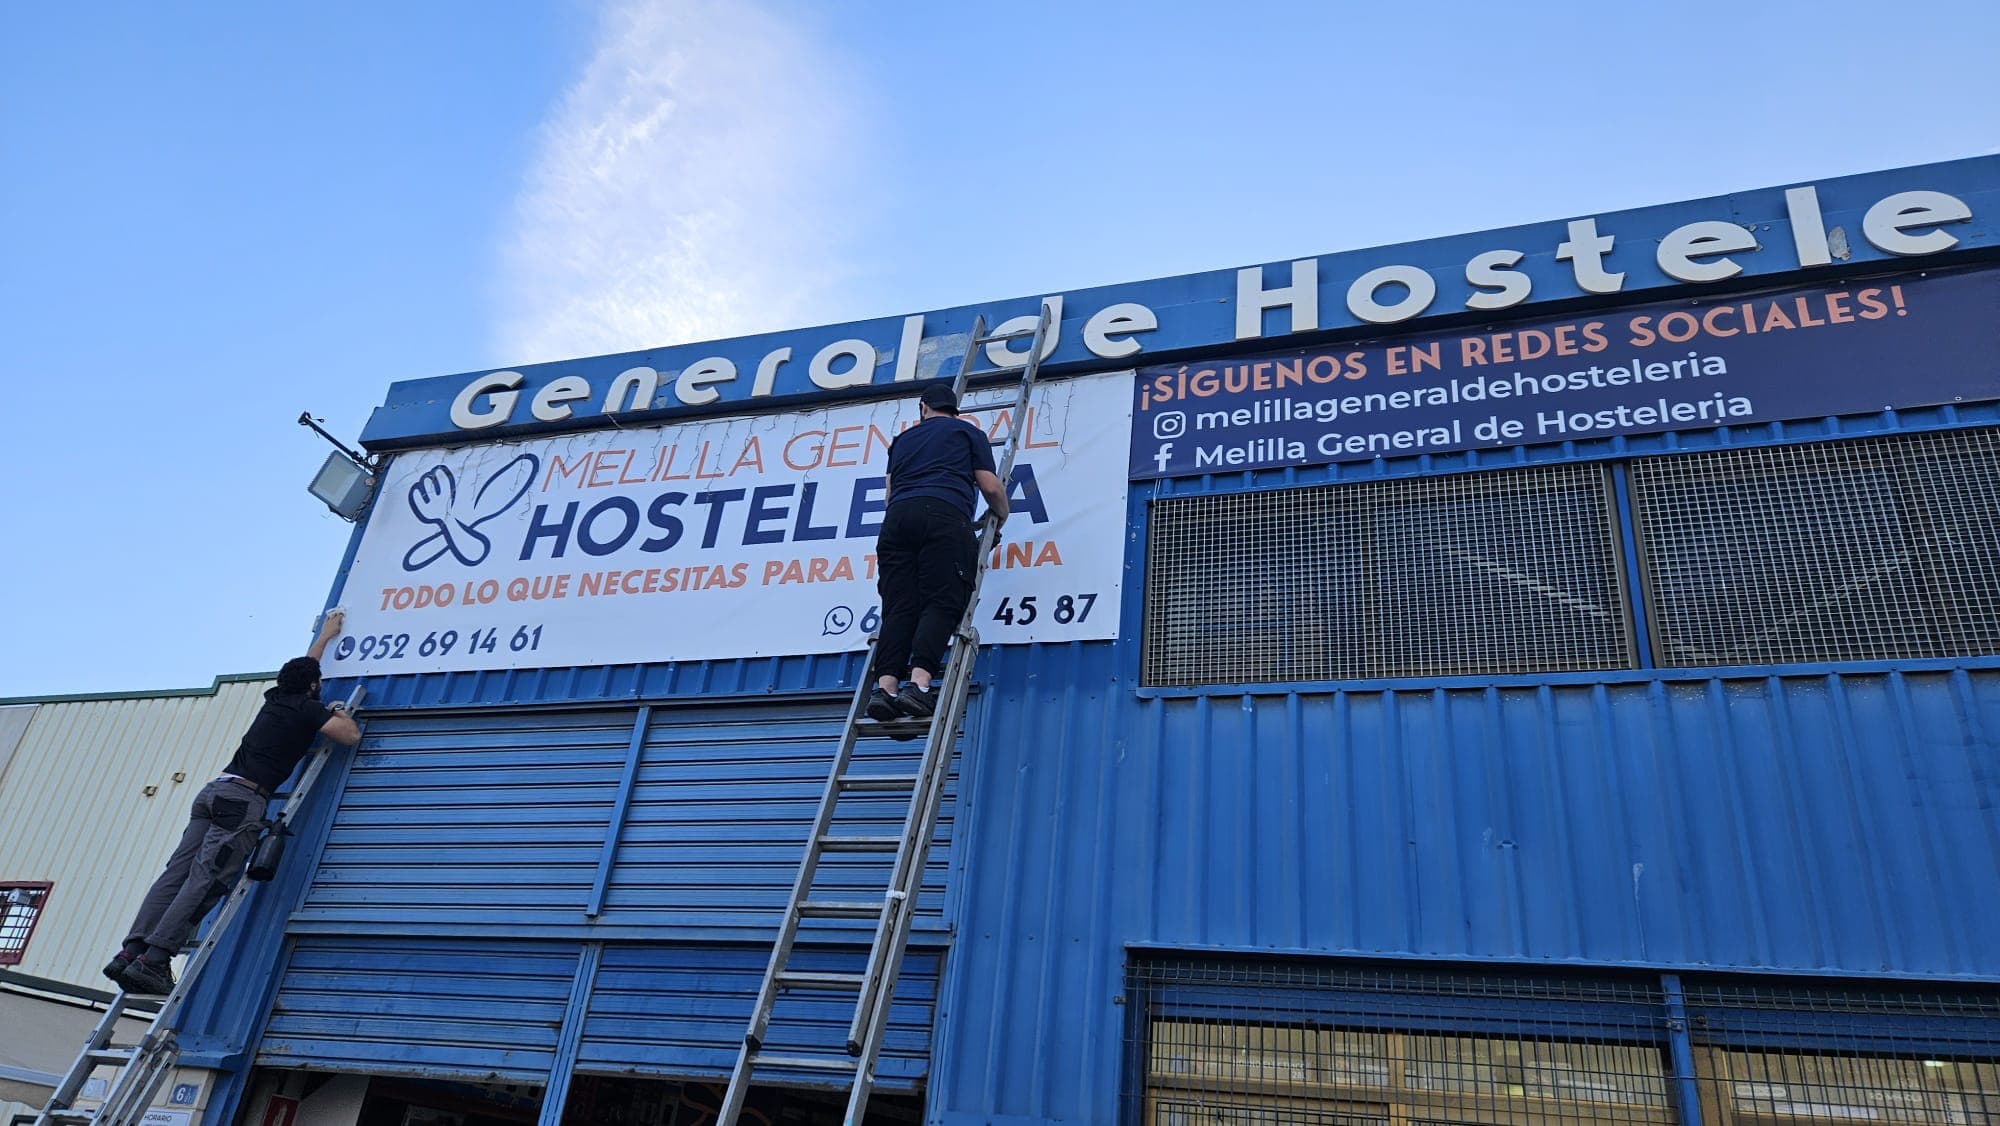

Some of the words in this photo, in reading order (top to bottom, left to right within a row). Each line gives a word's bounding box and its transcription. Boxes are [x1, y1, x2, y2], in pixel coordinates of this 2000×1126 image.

[448, 313, 926, 431] General
[984, 295, 1158, 367] de
[1234, 185, 1974, 341] Hostele
[1141, 350, 1368, 411] ¡SÍGUENOS
[1386, 342, 1441, 376] EN
[1461, 321, 1609, 367] REDES
[1629, 285, 1908, 347] SOCIALES!
[1194, 437, 1306, 469] Melilla
[1317, 420, 1462, 457] General
[1473, 415, 1524, 441] de
[1537, 391, 1754, 437] Hosteleria
[1195, 351, 1727, 431] melillageneraldehosteleria
[541, 435, 766, 493] MELILLA
[782, 407, 1059, 470] GENAL
[518, 463, 1050, 561] HOSTELEA
[380, 585, 456, 612] TODO
[462, 578, 500, 607] LO
[505, 573, 571, 602] QUE
[577, 562, 750, 597] NECESITAS
[762, 556, 854, 586] PARA
[992, 596, 1038, 626] 45
[1053, 593, 1098, 624] 87
[358, 633, 410, 662] 952
[418, 629, 459, 657] 69
[468, 626, 498, 655] 14
[509, 623, 544, 652] 61
